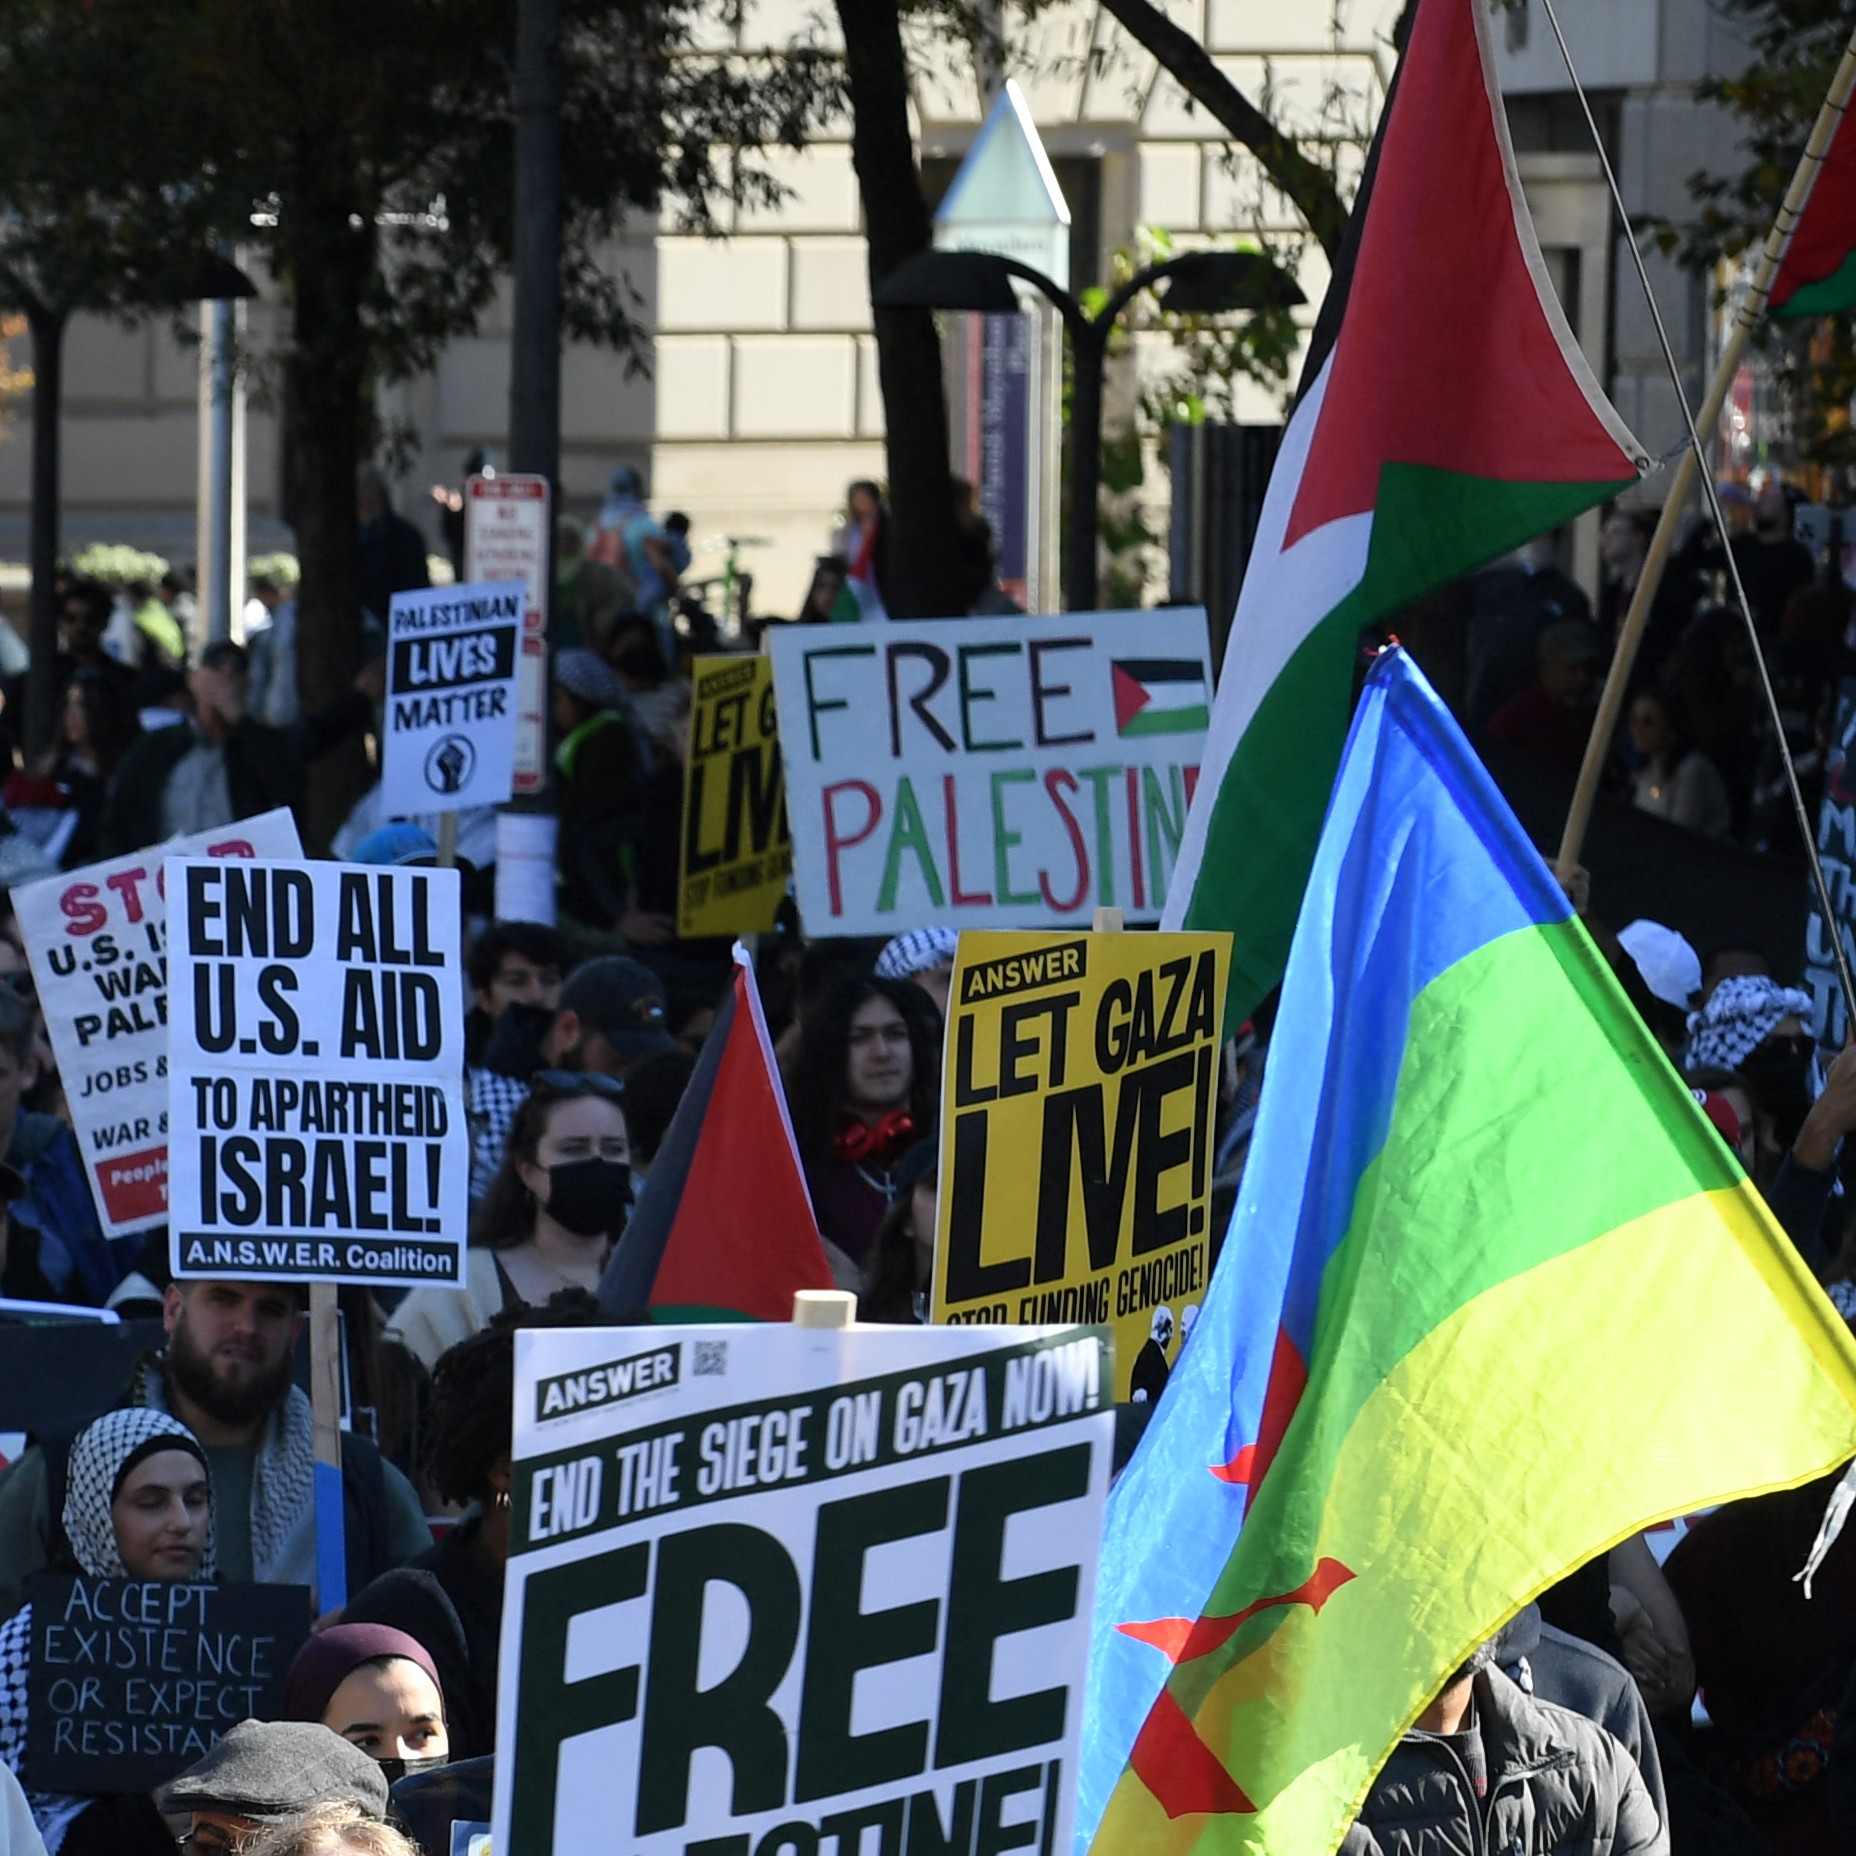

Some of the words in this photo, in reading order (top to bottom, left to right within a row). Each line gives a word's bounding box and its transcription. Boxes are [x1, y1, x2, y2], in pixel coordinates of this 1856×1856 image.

[394, 595, 519, 633] PALESTINIAN
[409, 633, 498, 686] LIVES
[394, 687, 507, 732] MATTER
[804, 637, 1095, 761] FREE
[688, 739, 789, 876] LIV
[823, 765, 1200, 917] PALESTIN
[186, 866, 315, 959] END
[337, 872, 444, 967] ALL
[47, 934, 134, 977] U.S.
[968, 948, 1080, 998] ANSWER
[194, 963, 319, 1056] U.S.
[340, 968, 442, 1061] AID
[955, 991, 1080, 1107] LET
[1095, 949, 1216, 1075] GAZA
[79, 1059, 148, 1098] JOBS
[191, 1076, 237, 1130] TO
[249, 1078, 448, 1138] APARTHEID
[92, 1116, 150, 1151] WAR
[199, 1135, 441, 1233] ISRAEL!
[946, 1045, 1212, 1304] LIVE!
[187, 1240, 340, 1269] A.N.S.W.E.R.
[346, 1244, 453, 1272] Coalition
[1116, 1243, 1204, 1317] GENOCIDE!
[542, 1353, 674, 1418] ANSWER
[529, 1456, 602, 1543] END
[616, 1432, 684, 1517] THE
[697, 1406, 813, 1496] SIEGE
[825, 1390, 883, 1470] ON
[893, 1366, 987, 1455] GAZA
[1002, 1336, 1100, 1429] NOW!
[64, 1578, 218, 1625] ACCEPT
[45, 1625, 275, 1677] EXISTENCE
[48, 1676, 105, 1714] OR
[126, 1678, 262, 1720] EXPECT
